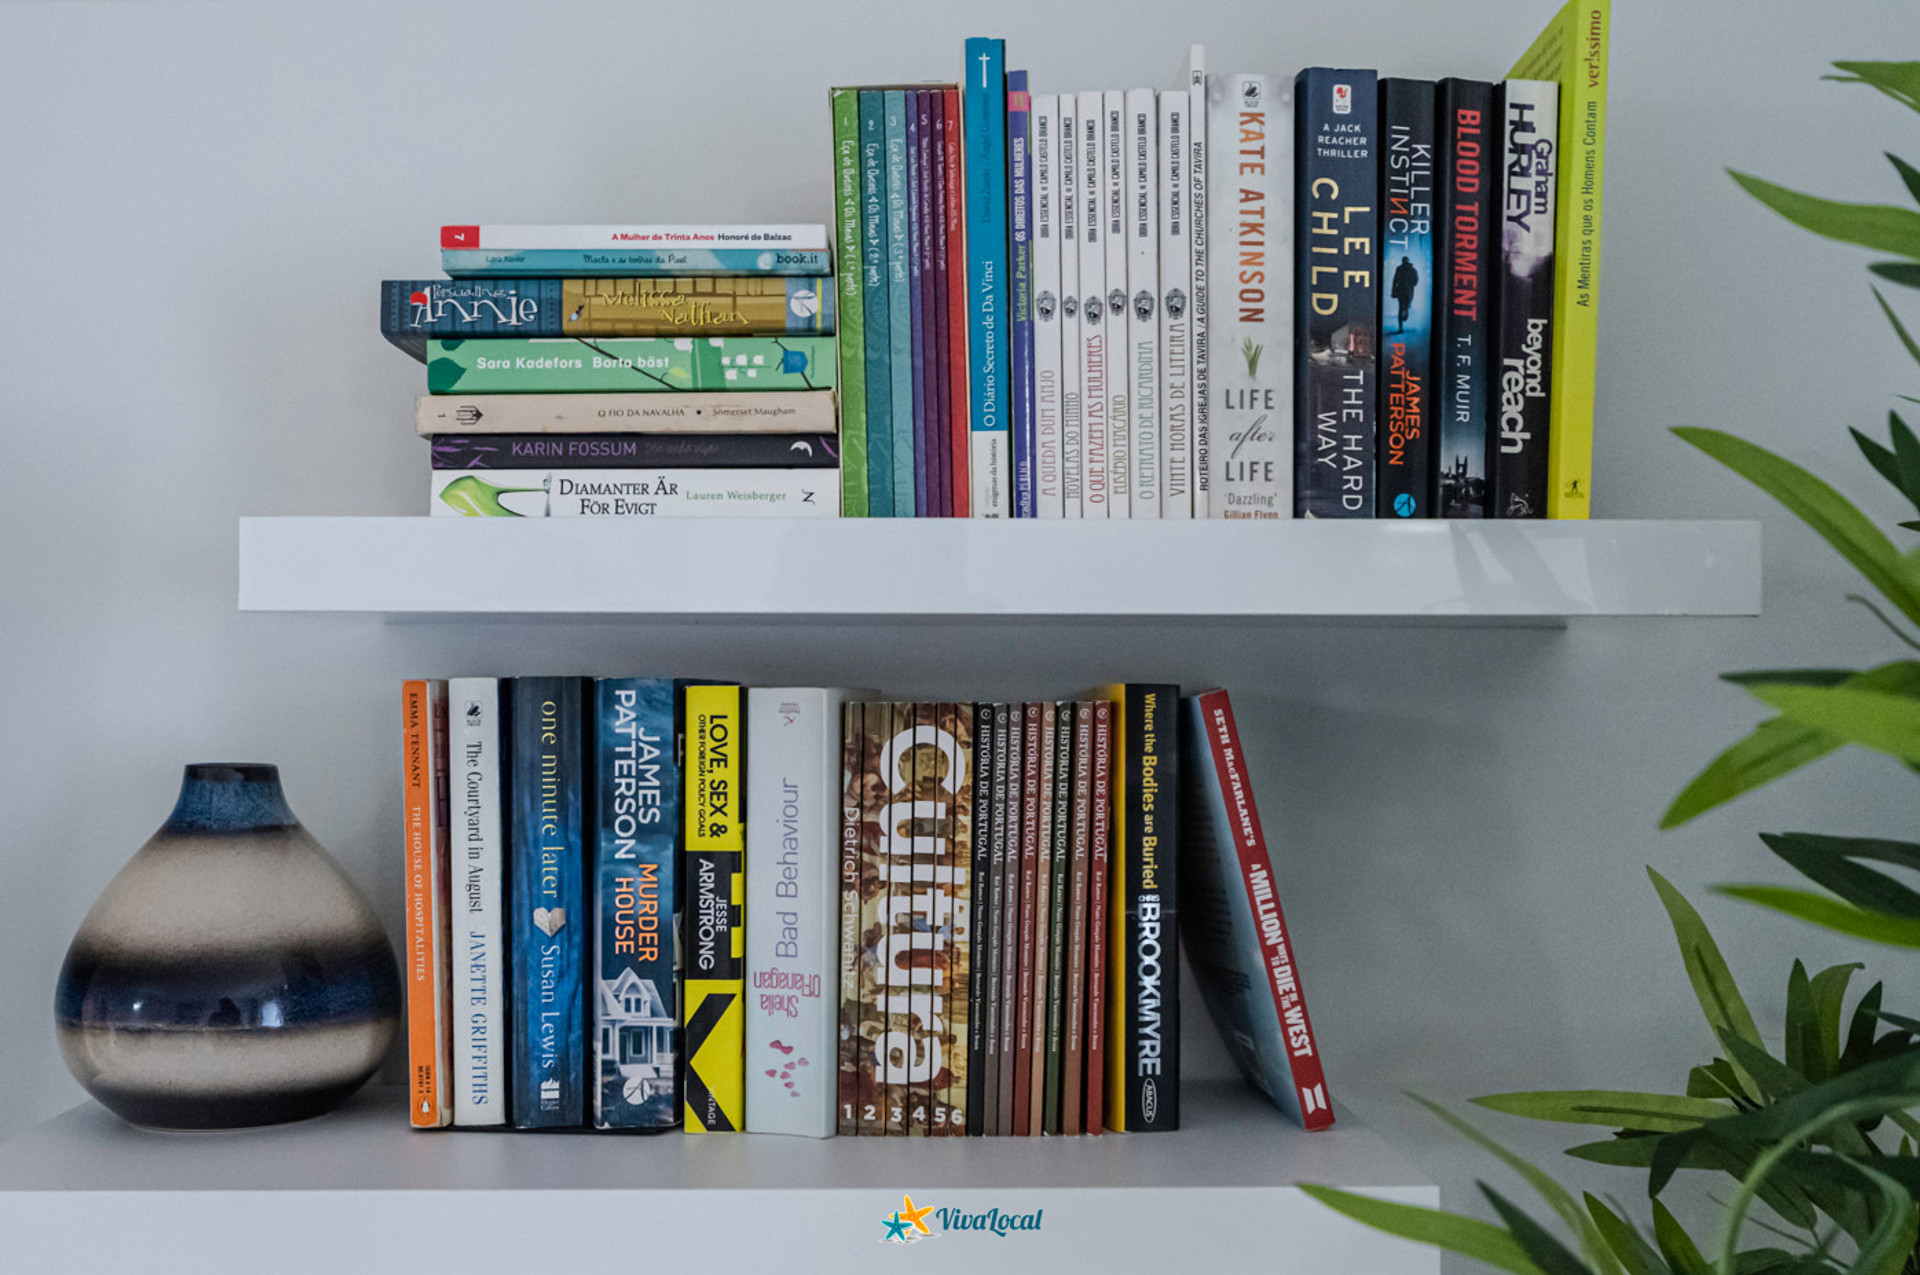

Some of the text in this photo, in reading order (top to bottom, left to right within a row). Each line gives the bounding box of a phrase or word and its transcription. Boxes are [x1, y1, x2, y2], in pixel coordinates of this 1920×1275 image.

[1239, 111, 1266, 176] KATE
[1316, 147, 1368, 158] THRILLER
[1317, 135, 1367, 146] REACHER
[1322, 123, 1362, 133] A JACK
[1389, 124, 1410, 251] INSTINCT
[1410, 143, 1431, 235] KILLER
[1506, 102, 1537, 234] HURLEY
[1534, 138, 1554, 214] Graham
[1576, 101, 1597, 308] As Mentiras que os Homens Contam
[454, 232, 465, 242] 7
[611, 232, 792, 241] A Mulher de Trinta Anos Honoré de Balzac
[1013, 137, 1028, 322] Victoria Parker OS DIREITOS DAS MULHERES
[1311, 177, 1339, 316] CHILD
[1344, 206, 1371, 288] LEE
[1453, 108, 1481, 321] BLOOD TORMENT
[602, 281, 687, 308] Melissa
[776, 253, 819, 265] book.it
[1239, 188, 1266, 323] ATKINSON
[410, 287, 538, 329] Annie
[659, 301, 749, 326] Nathan
[981, 260, 996, 427] O Diário Secreto de Da Vinci
[477, 357, 510, 369] Sara
[516, 356, 583, 369] Kadefors
[637, 356, 670, 369] bäst
[1455, 334, 1472, 423] T. F. MUIR
[1521, 318, 1548, 397] beyond
[598, 407, 796, 418] O FIO DA NAVALHA Somerset Maugham
[1086, 334, 1105, 504] O QUE FAZEM AS MULHERES
[1169, 323, 1186, 497] VINTE HORAS DE LITEIRA
[1225, 388, 1275, 410] LIFE
[1228, 414, 1275, 460] after
[1388, 342, 1405, 466] PATTERSON
[1405, 370, 1421, 440] JAMES
[1500, 358, 1531, 453] reach
[512, 442, 563, 456] KARIN
[569, 442, 637, 456] FOSSUM
[1225, 461, 1275, 482] LIFE
[1317, 412, 1337, 469] WAY
[1342, 370, 1363, 511] THE HARD
[559, 476, 678, 496] DIAMANTER ÄR
[580, 498, 657, 515] FÖR EVIGT
[686, 490, 787, 503] Lauren Weisberger
[466, 741, 484, 768] The
[1213, 708, 1230, 746] SETH
[464, 771, 485, 842] Courtyard
[541, 700, 565, 898] one minute later
[614, 689, 637, 859] PATTERSON
[638, 726, 661, 824] JAMES
[698, 714, 707, 838] OTHER FOREIGN POLICY GOALS
[706, 714, 728, 838] LOVE, SEX &
[1094, 724, 1109, 861] HISTÓRIA DE PORTUGAL
[1142, 693, 1159, 889] Where the Bodies are Buried
[409, 692, 425, 981] EMMA TENNANT THE HOUSE OF HOSPITALITIES
[467, 846, 485, 860] in
[775, 777, 799, 958] Bad Behaviour
[465, 864, 485, 914] August
[614, 876, 635, 955] HOUSE
[638, 863, 659, 962] MURDER
[698, 858, 715, 971] ARMSTRONG
[715, 895, 728, 933] JESSE
[842, 806, 860, 990] Dietrich Schwanitz
[874, 725, 967, 1085] Cultura
[1249, 863, 1284, 946] A MILLION
[469, 930, 486, 1006] JANETTE
[540, 944, 561, 1069] Susan Lewis
[760, 993, 799, 1018] Sheila
[1137, 902, 1162, 1077] BROOKMYRE
[1273, 965, 1313, 1058] DIE WEST
[471, 1013, 488, 1105] GRIFFITHS
[707, 1086, 716, 1125] VINTAGE
[844, 1104, 964, 1125] 1 2 3 4 5 6
[1145, 1084, 1155, 1118] ABACUS
